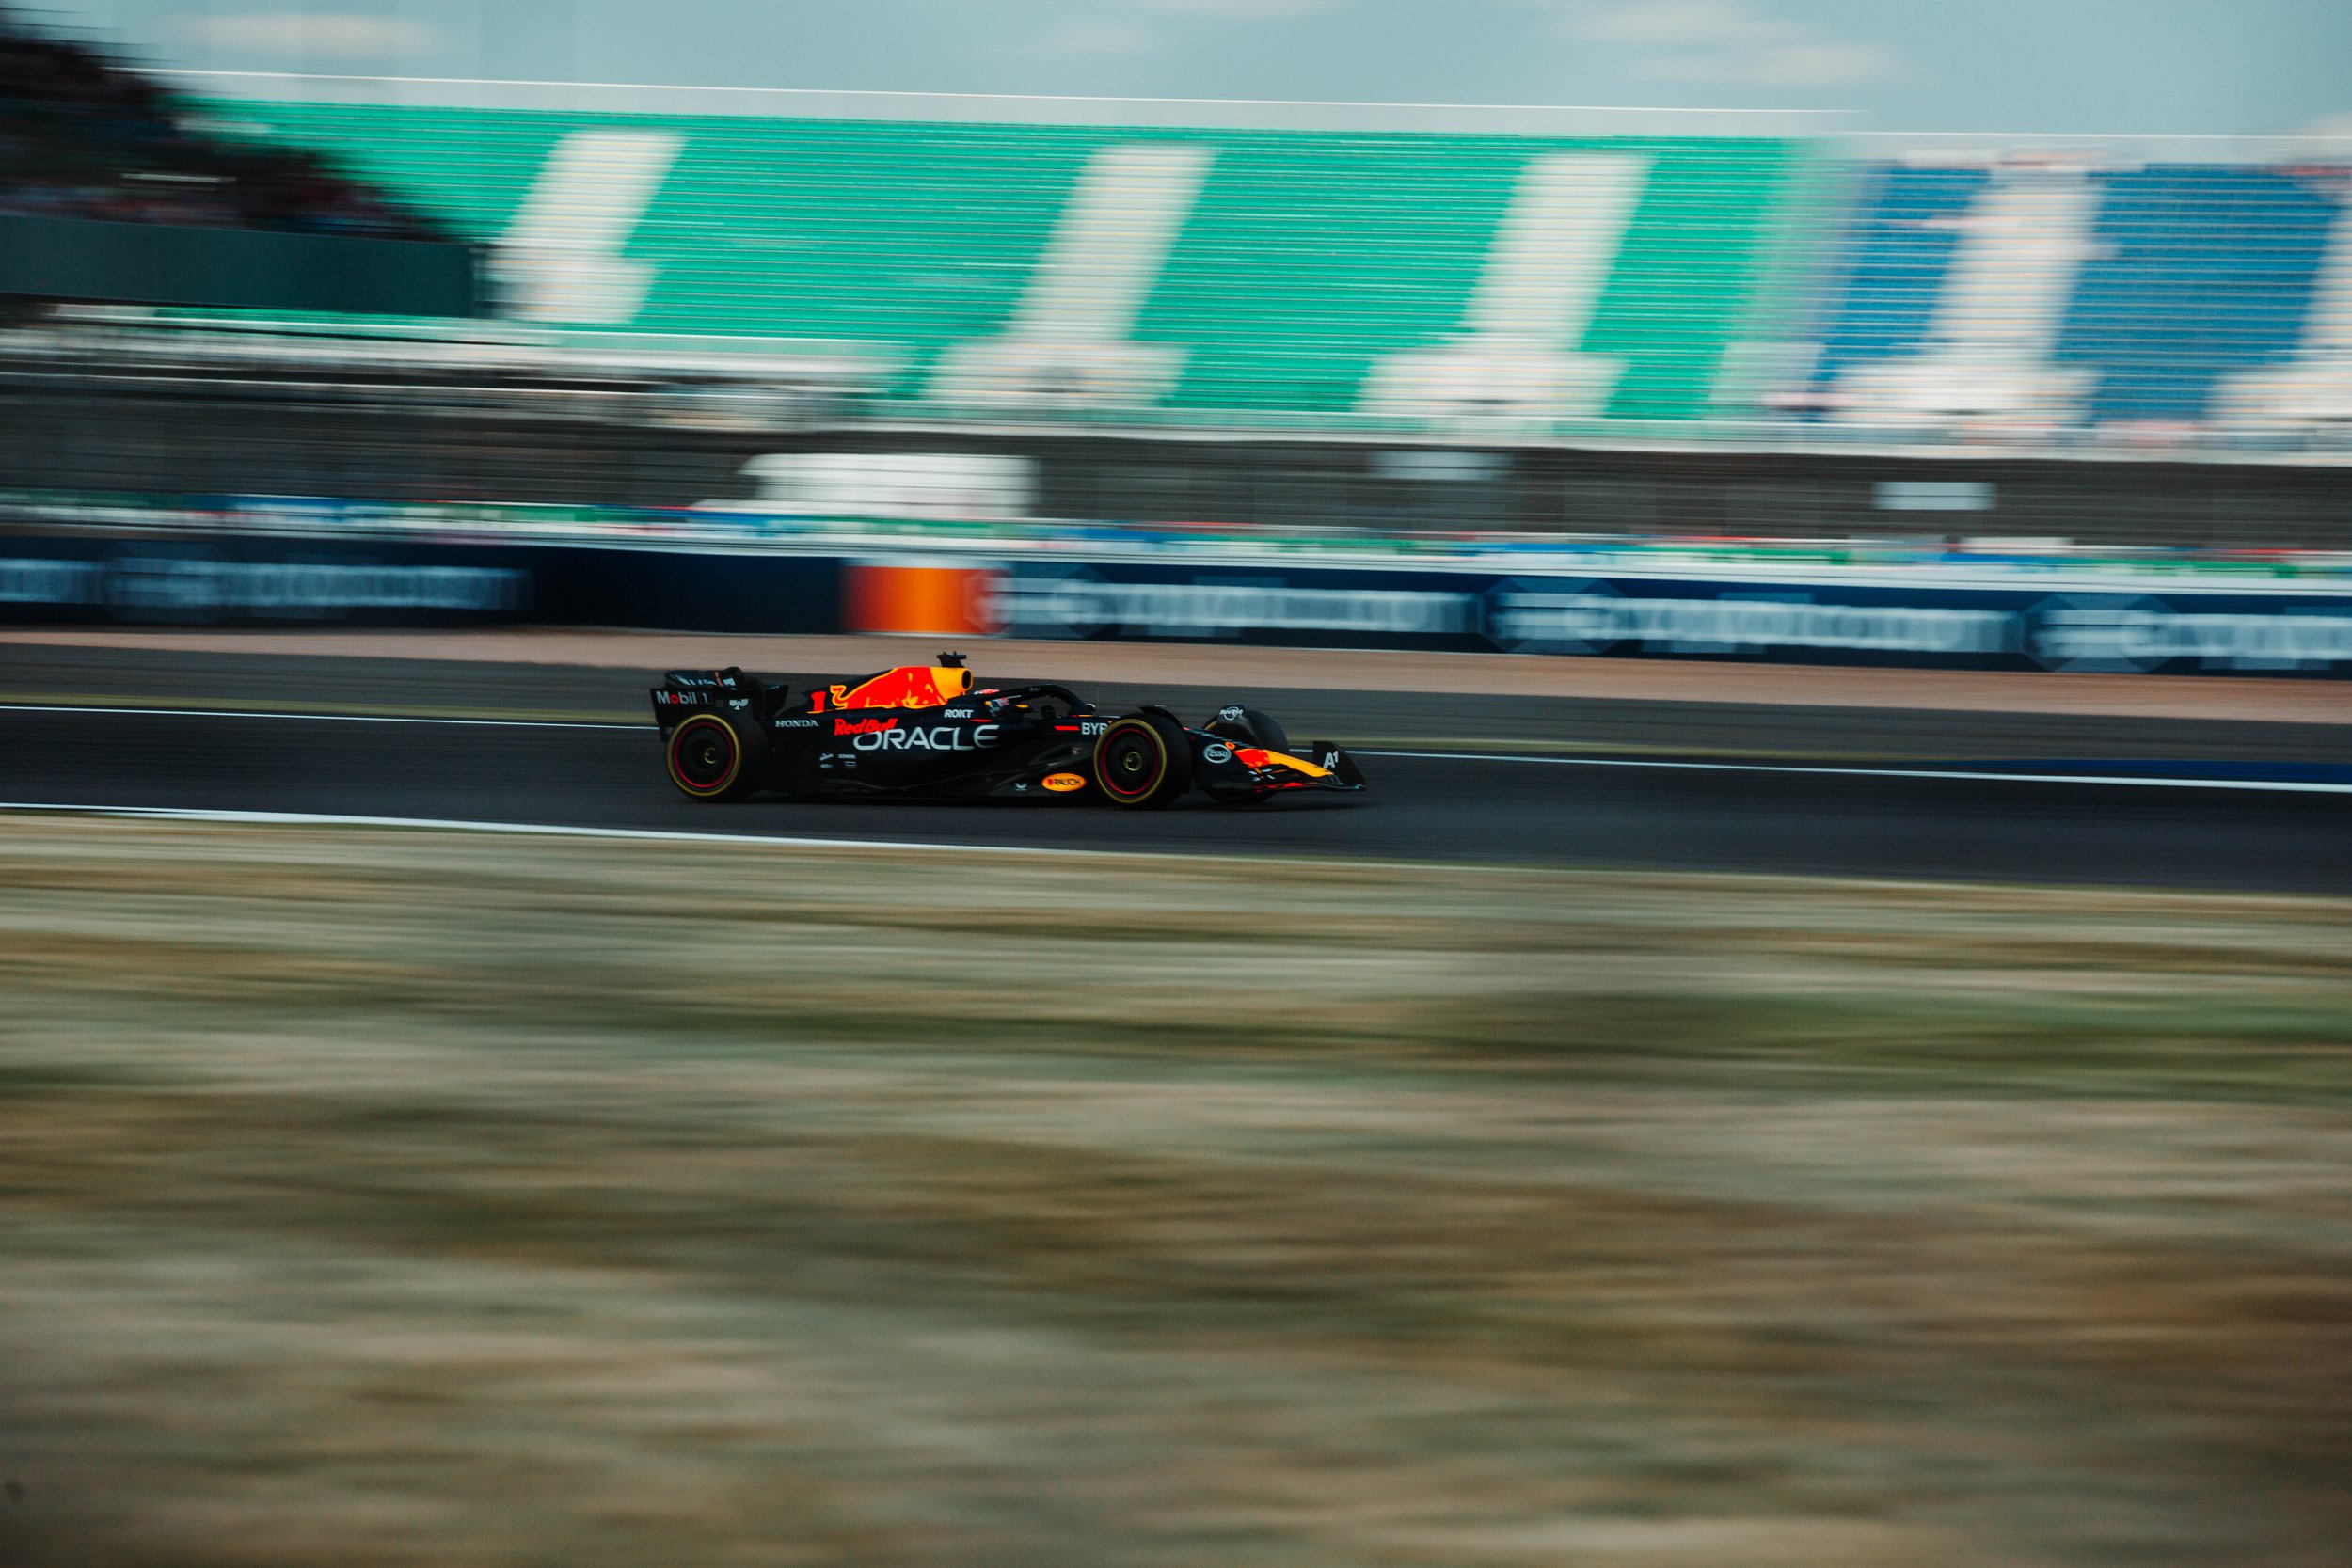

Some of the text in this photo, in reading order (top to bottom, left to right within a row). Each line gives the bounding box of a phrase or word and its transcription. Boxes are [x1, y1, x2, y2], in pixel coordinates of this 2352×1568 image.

[655, 690, 697, 705] Mobil
[810, 690, 826, 712] 1
[944, 709, 974, 718] ROKT
[775, 720, 819, 728] HONDA
[834, 718, 867, 736] Red
[853, 724, 1000, 751] ORACLE
